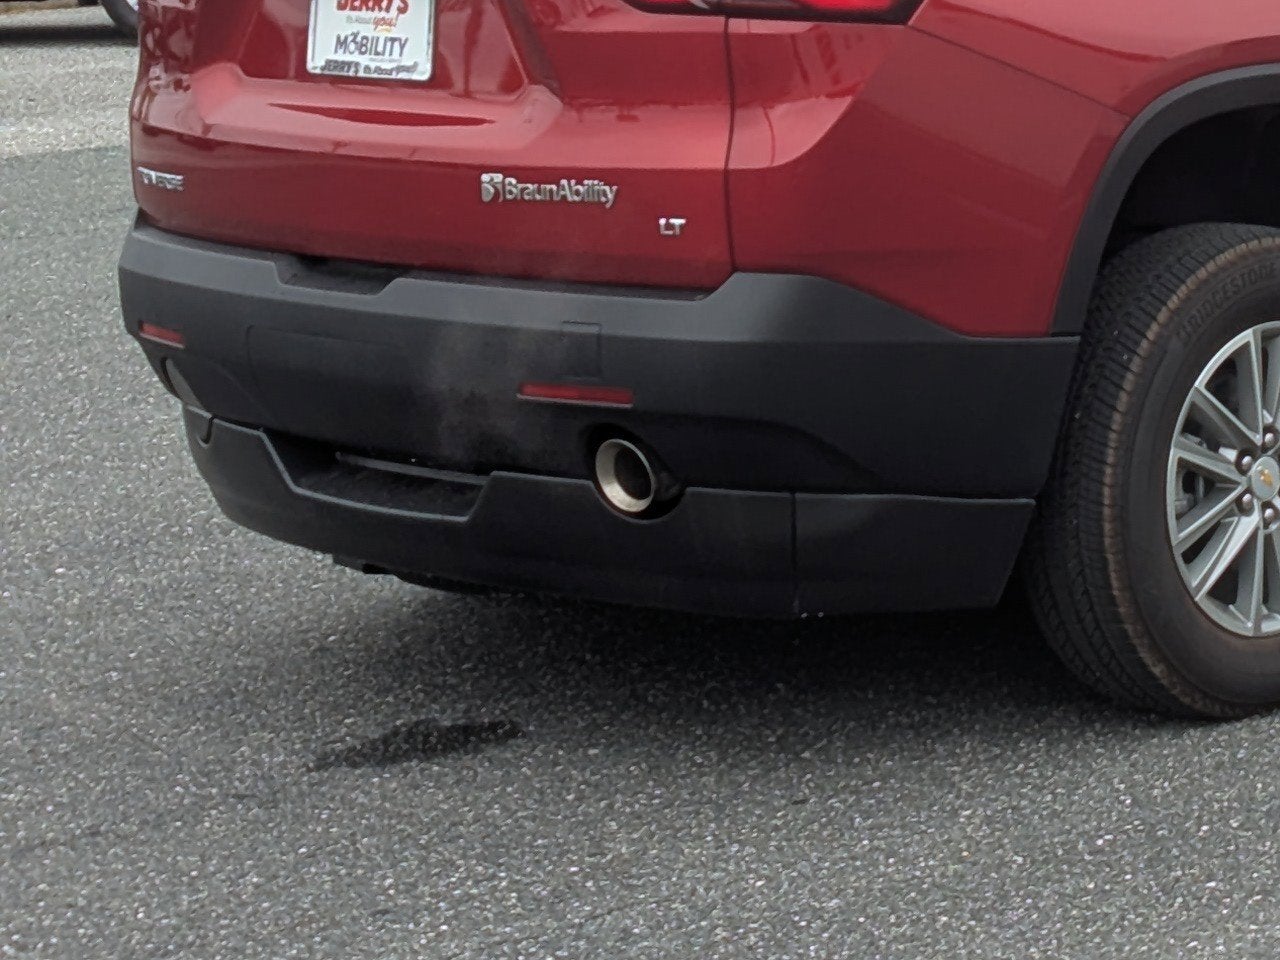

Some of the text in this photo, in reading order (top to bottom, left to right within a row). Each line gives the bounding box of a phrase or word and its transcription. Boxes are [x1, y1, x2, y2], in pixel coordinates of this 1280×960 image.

[334, 31, 409, 57] MOBILITY
[505, 177, 618, 209] BraunAbility
[658, 217, 687, 236] LT
